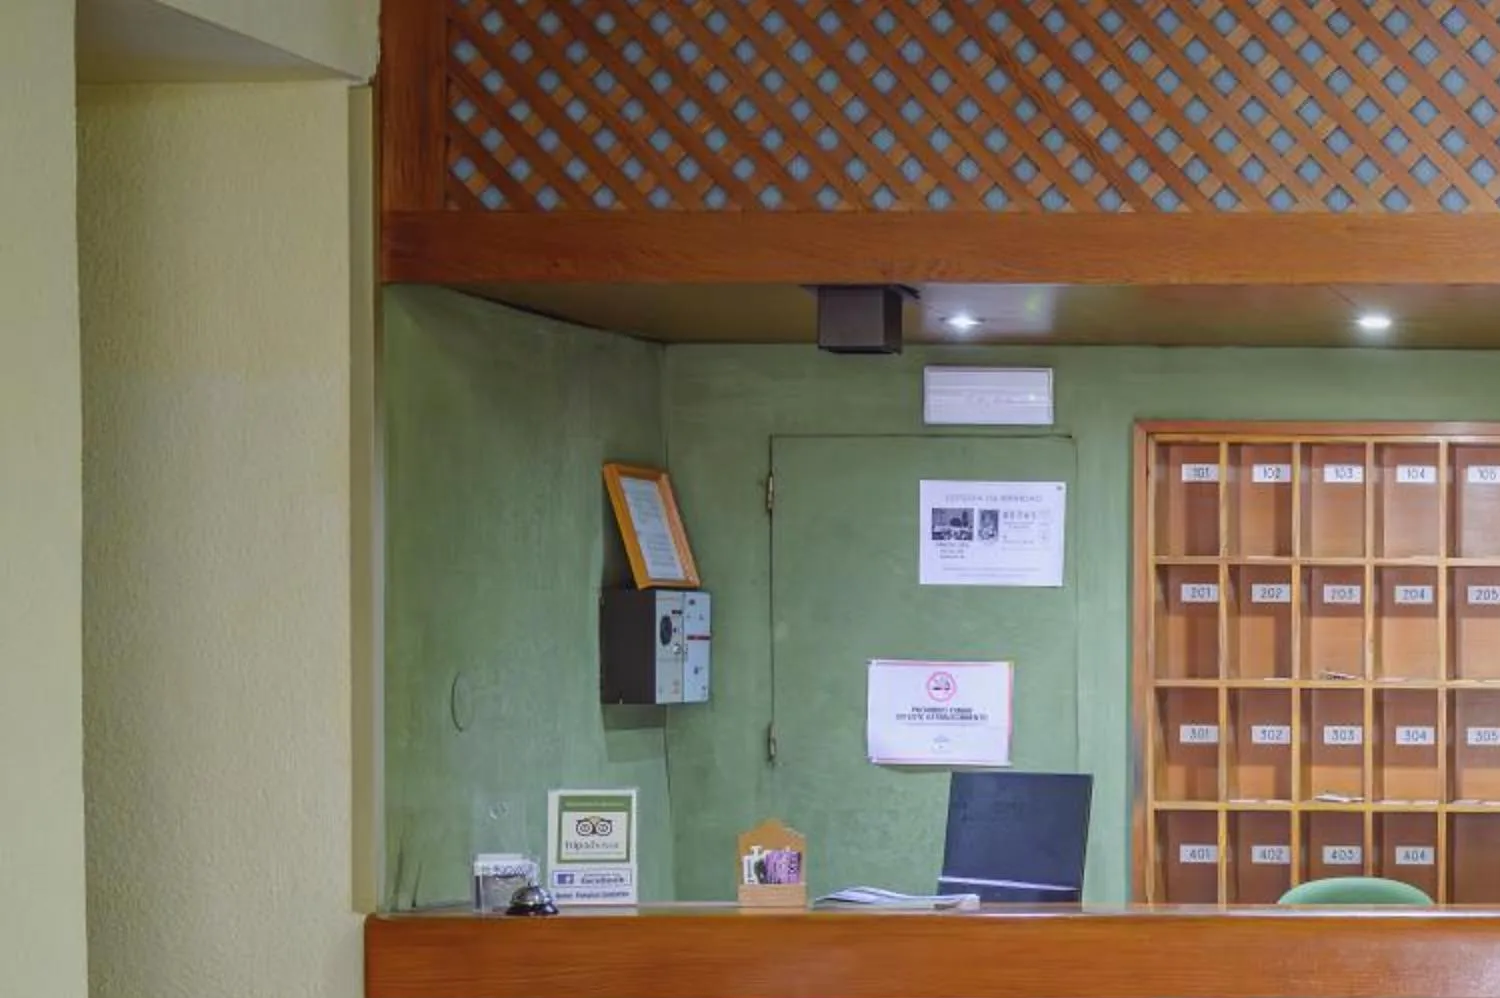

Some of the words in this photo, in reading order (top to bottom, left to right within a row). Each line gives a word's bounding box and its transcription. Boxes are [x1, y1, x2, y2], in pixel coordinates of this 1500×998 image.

[1192, 467, 1210, 479] 101
[1262, 467, 1282, 479] 102
[1335, 467, 1354, 479] 103
[1407, 467, 1425, 479] 104
[1190, 587, 1211, 598] 201
[1260, 587, 1283, 598] 202
[1403, 589, 1425, 600] 204
[1476, 589, 1499, 600] 205
[1190, 728, 1209, 739] 301
[1260, 729, 1283, 740] 302
[1331, 729, 1354, 741] 303
[1402, 730, 1426, 741] 304
[1476, 730, 1499, 742] 305
[1190, 849, 1211, 860] 401
[1260, 849, 1283, 860] 402
[1331, 849, 1354, 861] 403
[1403, 849, 1425, 861] 404
